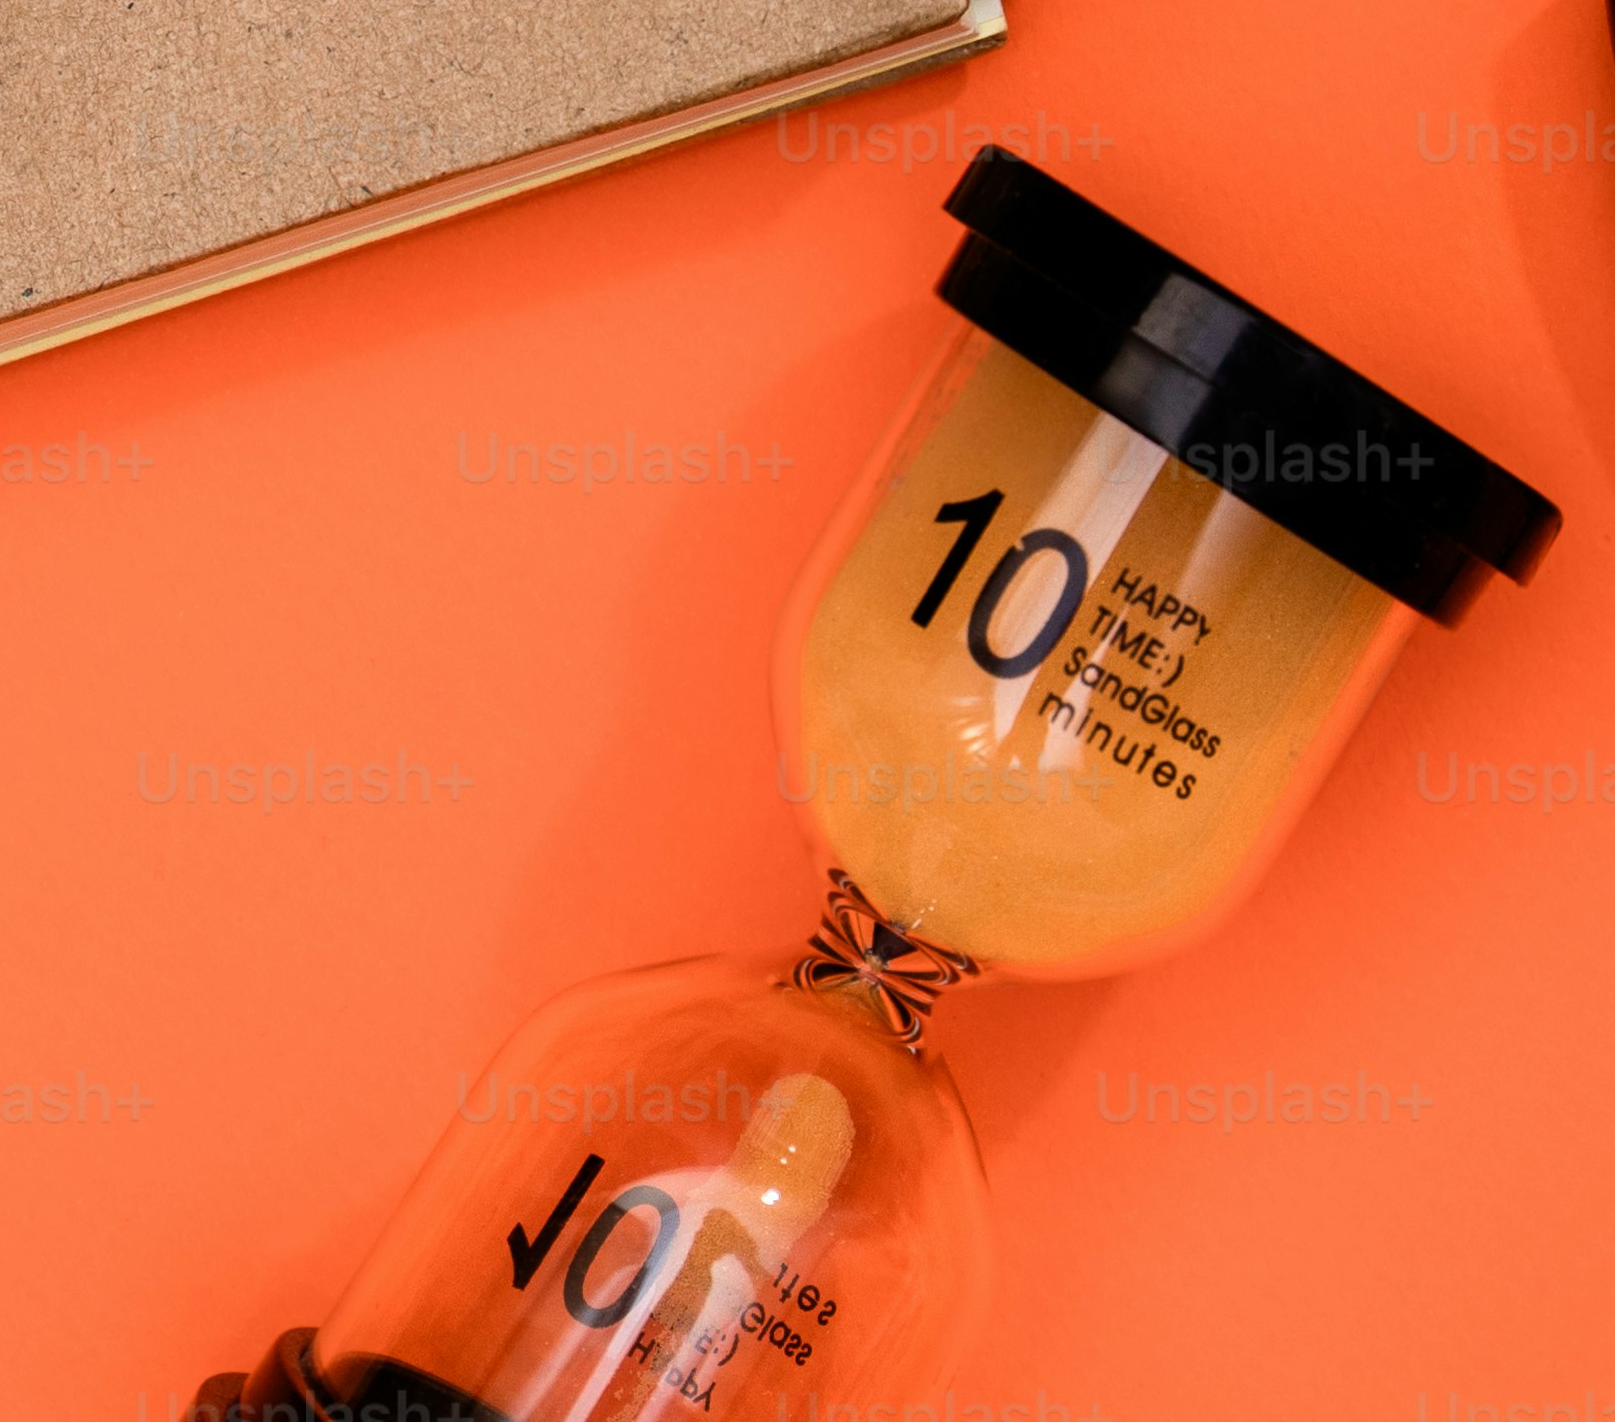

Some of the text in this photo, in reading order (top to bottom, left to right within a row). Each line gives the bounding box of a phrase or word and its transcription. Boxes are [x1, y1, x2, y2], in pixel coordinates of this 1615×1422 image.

[909, 487, 1089, 681] 10
[1110, 566, 1213, 647] HAPPY
[1037, 691, 1197, 800] minutes
[1063, 645, 1223, 759] SandGlass
